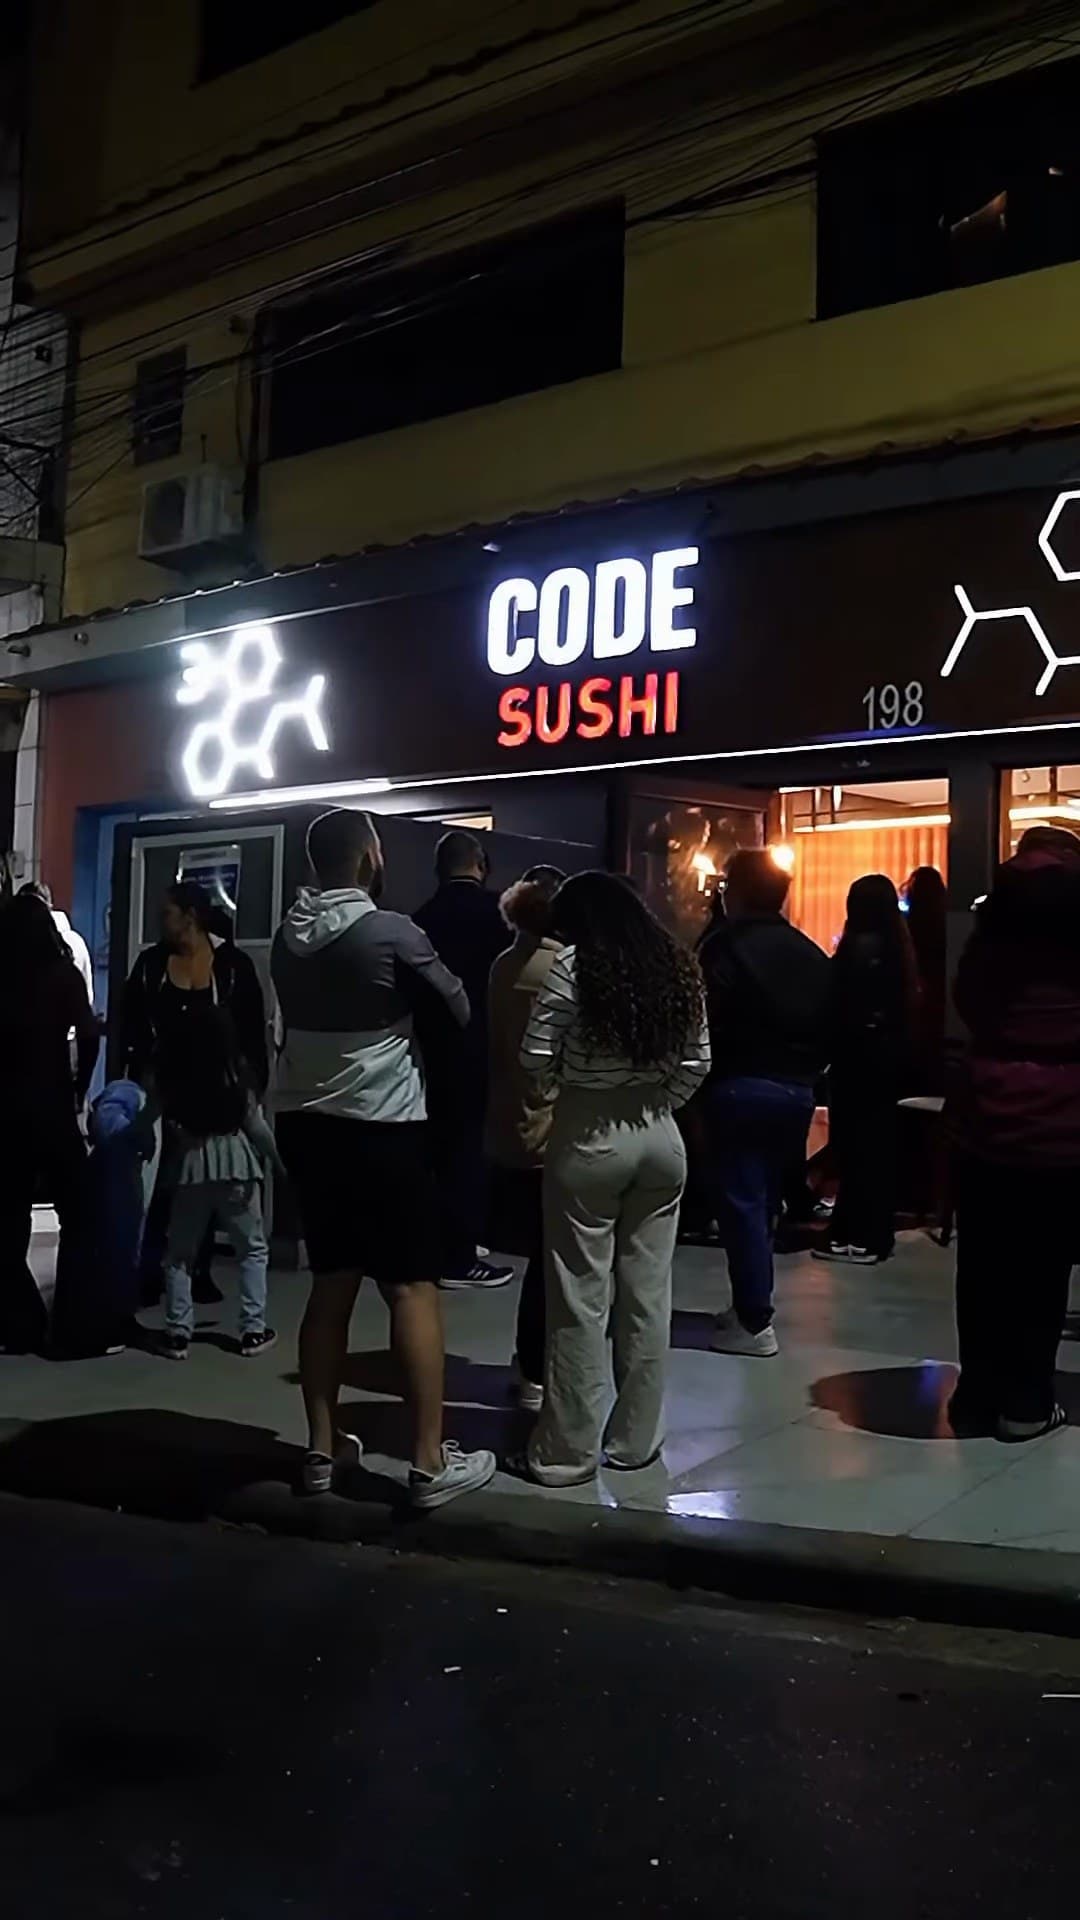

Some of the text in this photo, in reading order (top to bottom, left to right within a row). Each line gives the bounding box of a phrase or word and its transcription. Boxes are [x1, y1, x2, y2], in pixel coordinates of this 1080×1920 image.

[487, 546, 699, 675] CODE
[497, 671, 678, 746] SUSHI
[862, 681, 923, 730] 198
